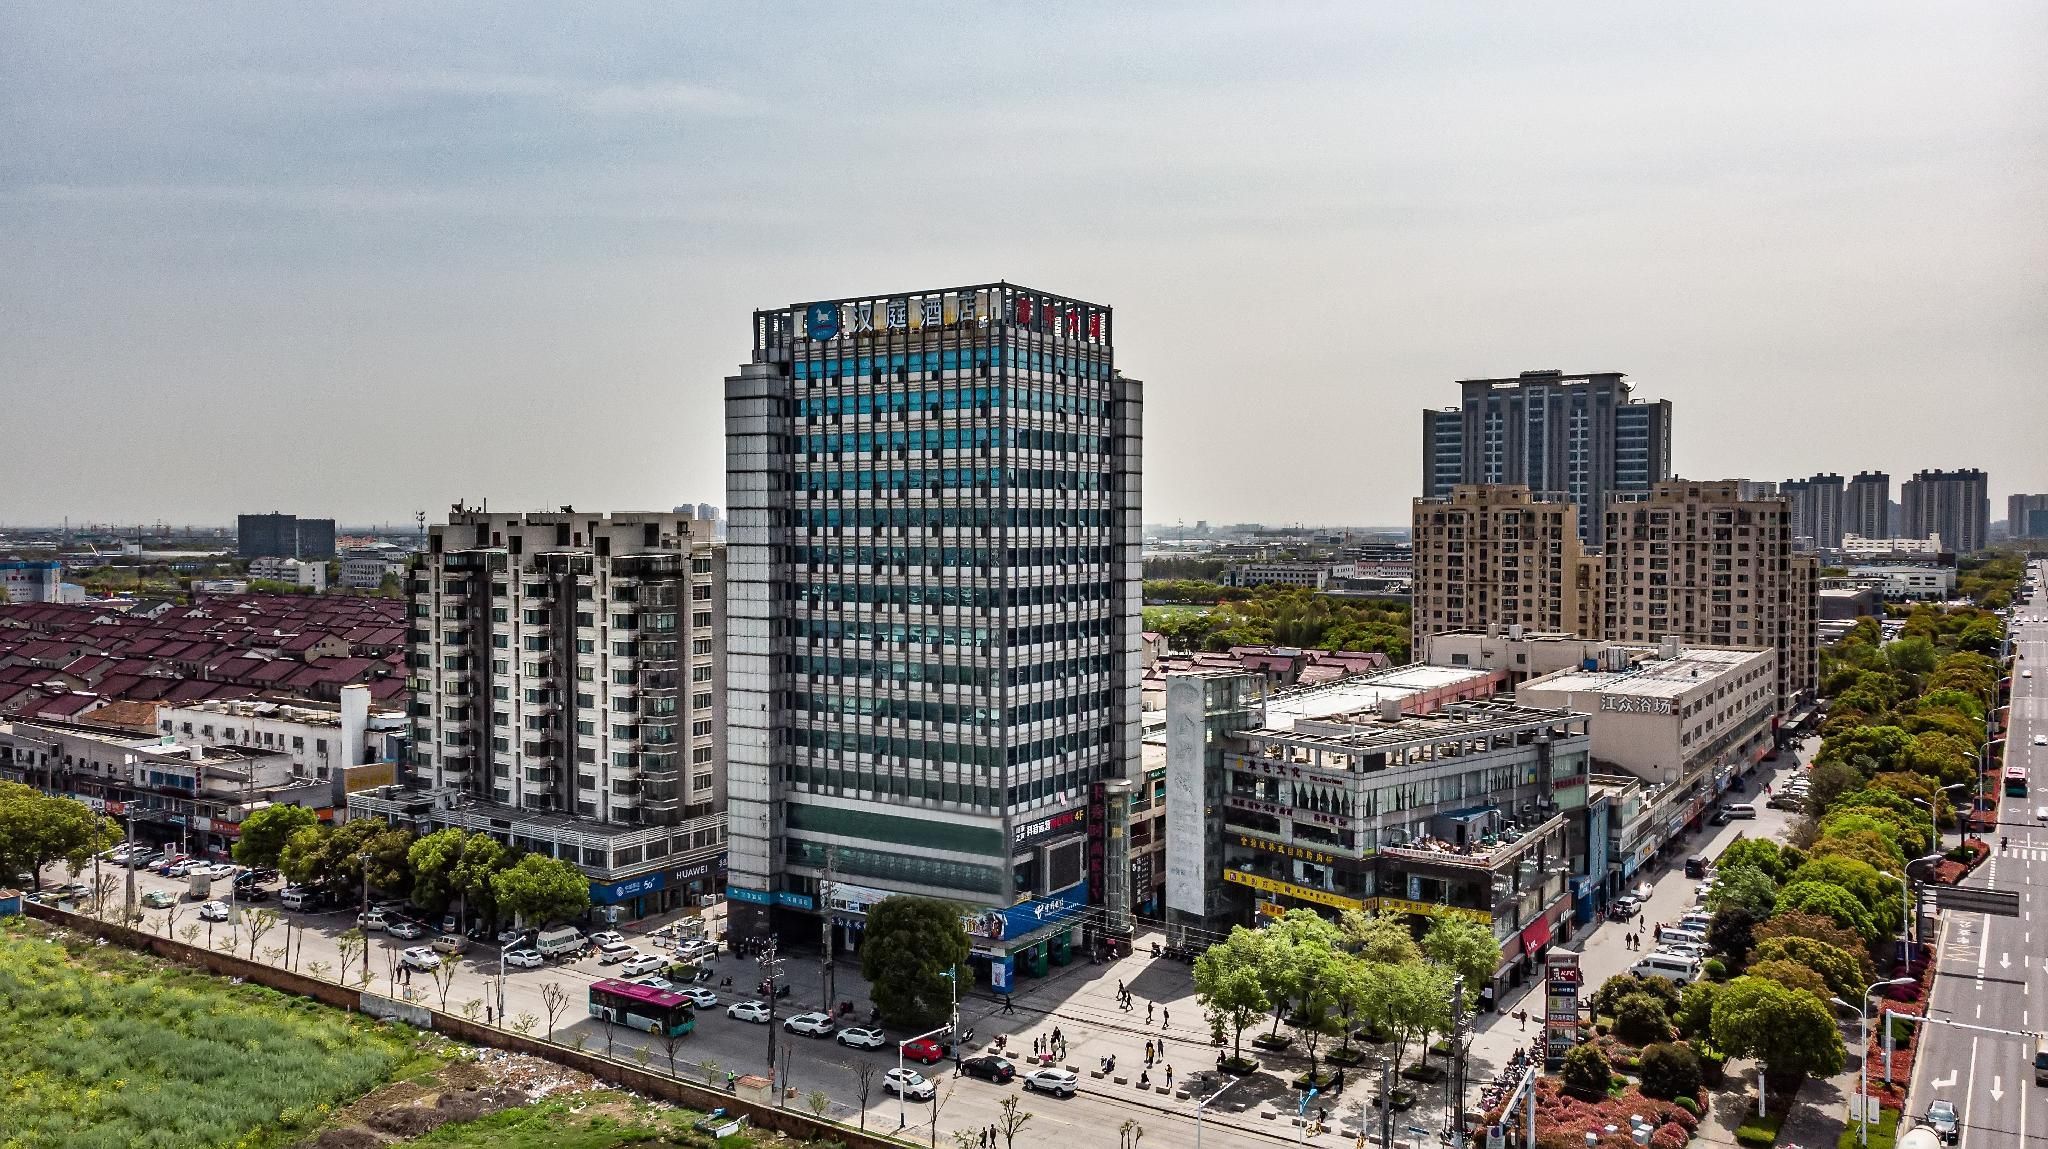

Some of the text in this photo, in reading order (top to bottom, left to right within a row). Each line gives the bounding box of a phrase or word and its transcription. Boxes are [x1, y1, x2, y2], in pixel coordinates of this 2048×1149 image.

[854, 291, 976, 333] 汉庭酒店
[1601, 694, 1671, 715] 江众浴场
[1074, 809, 1084, 821] 4F
[676, 865, 708, 880] HUAWEI
